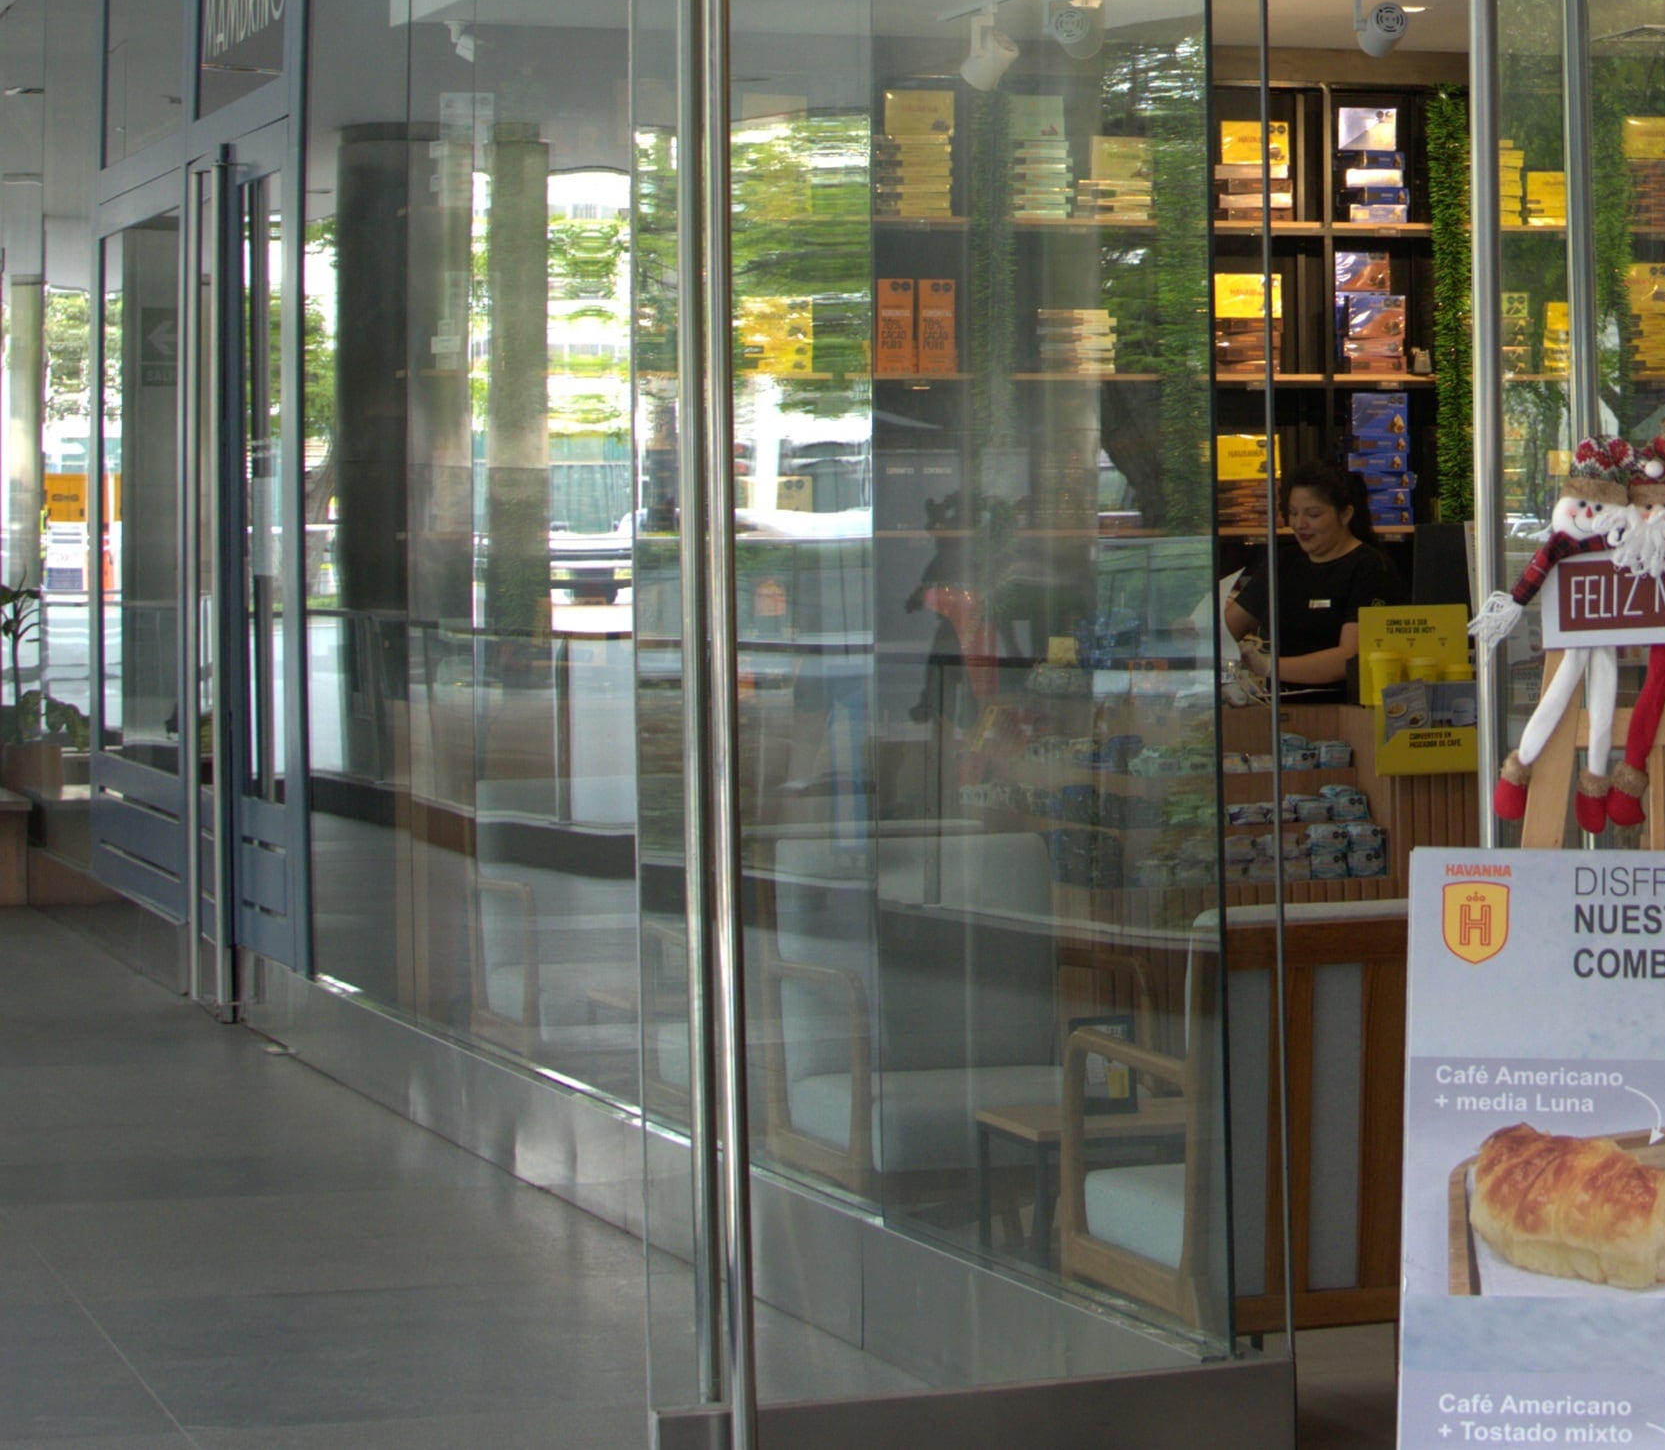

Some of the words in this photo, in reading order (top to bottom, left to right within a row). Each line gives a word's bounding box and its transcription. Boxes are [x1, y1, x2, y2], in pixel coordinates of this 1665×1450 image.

[1570, 571, 1644, 619] FELIZ
[1445, 863, 1512, 877] HAVANNA
[1435, 1065, 1489, 1084] Café
[1495, 1066, 1624, 1086] Americano
[1435, 1094, 1449, 1108] +
[1456, 1093, 1528, 1111] media
[1536, 1093, 1594, 1112] Luna
[1438, 1393, 1494, 1413] Café
[1500, 1394, 1633, 1416] Americano
[1437, 1423, 1453, 1438] +
[1460, 1421, 1557, 1442] Tostado
[1565, 1424, 1633, 1443] mixto
